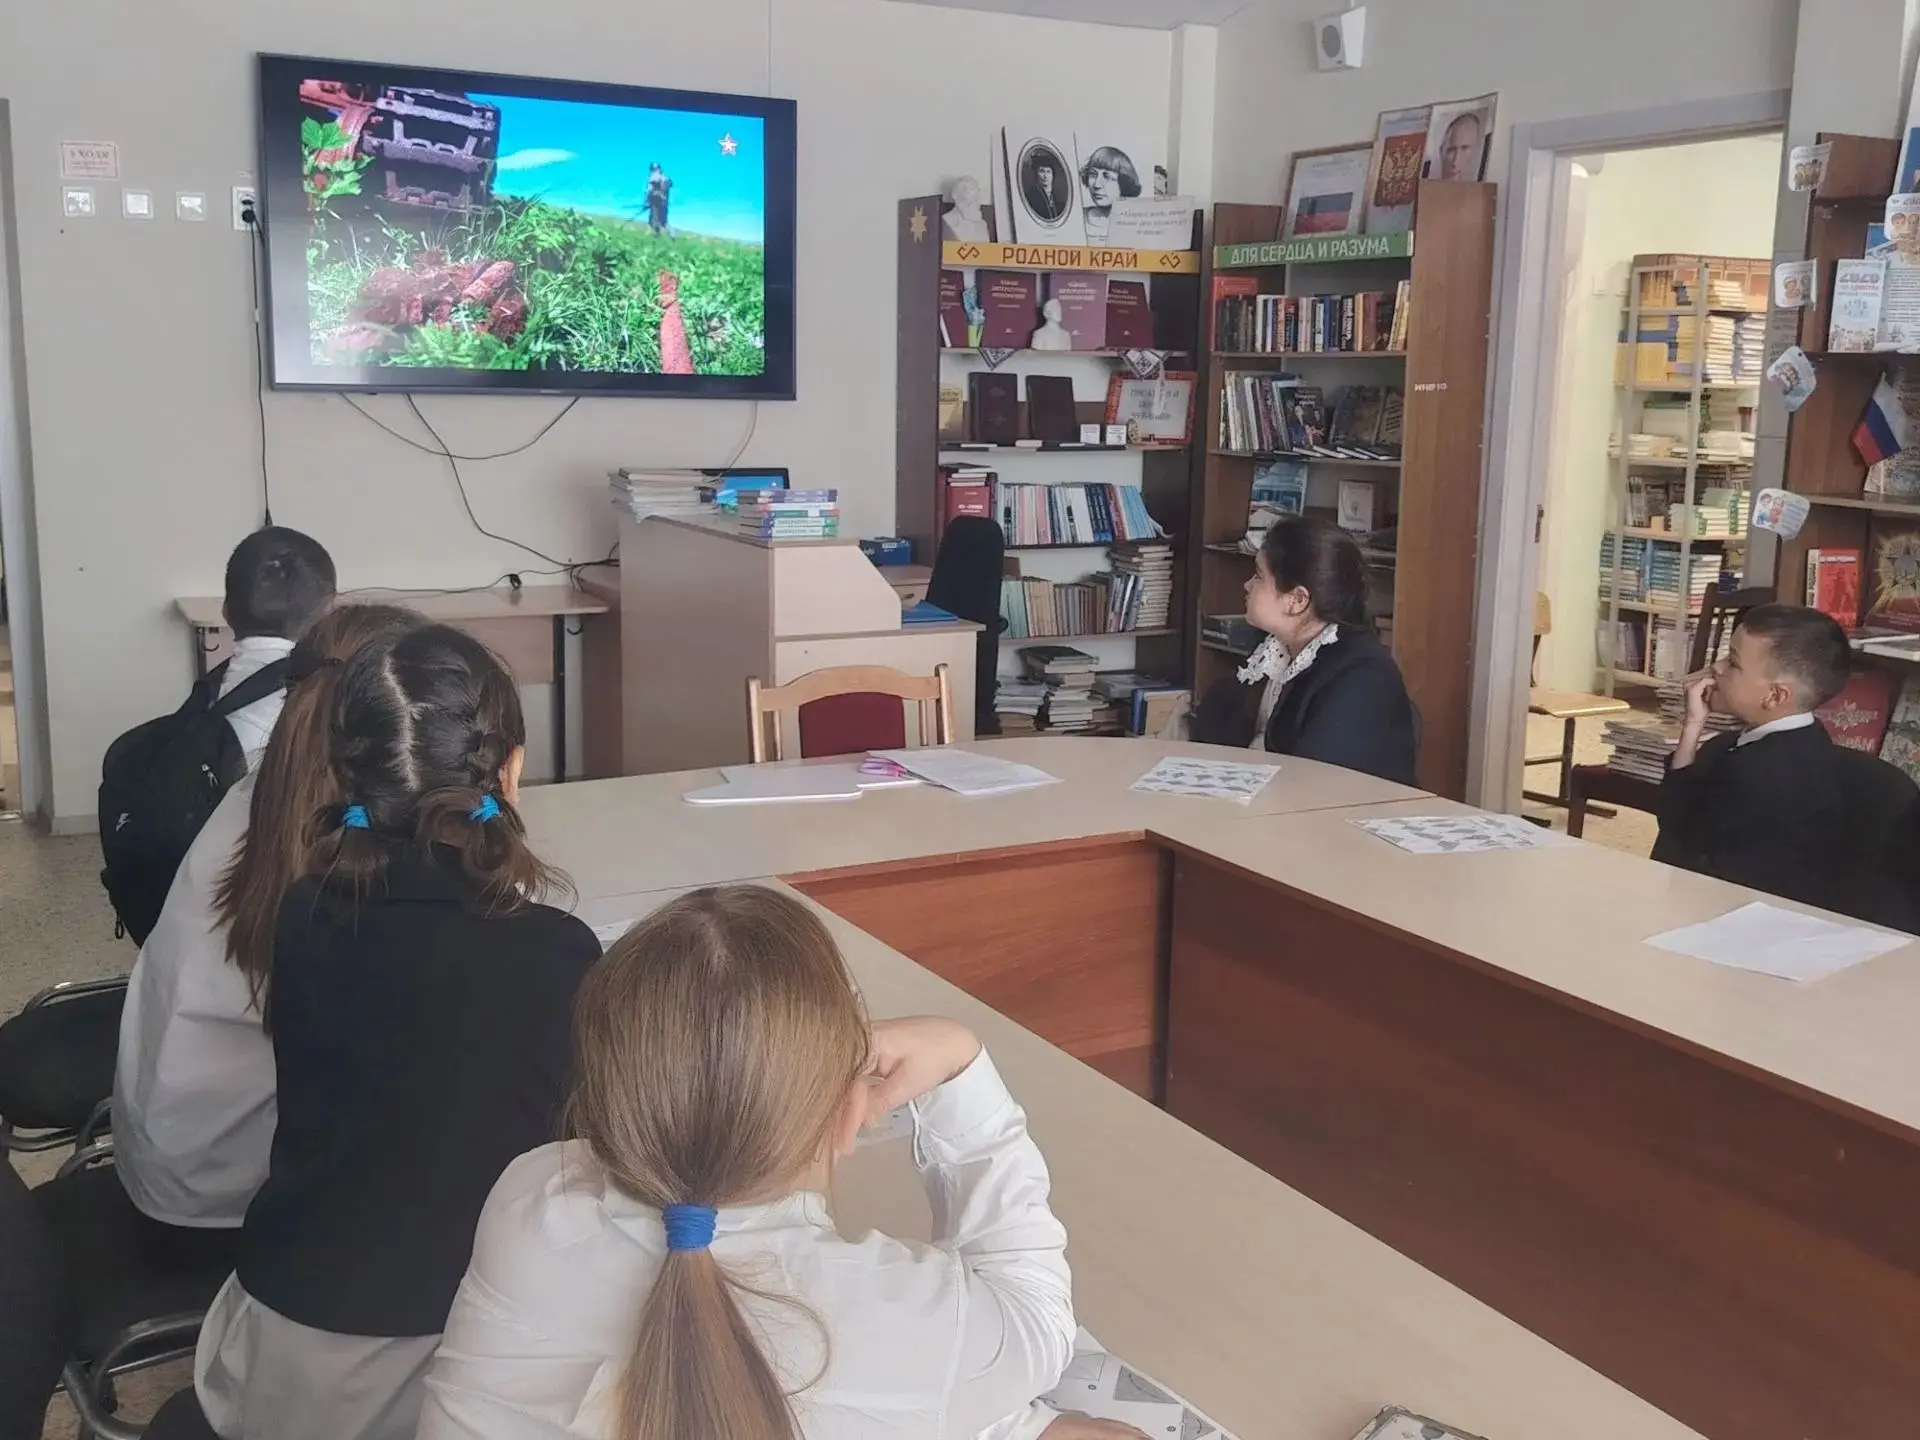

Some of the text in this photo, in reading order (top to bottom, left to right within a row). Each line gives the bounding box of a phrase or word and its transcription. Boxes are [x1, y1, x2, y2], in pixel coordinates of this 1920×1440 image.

[1002, 247, 1138, 268] РОДНОЙ КРАЙ
[1231, 236, 1389, 264] ДЛЯ СЕРДЦА И РАЗУМА
